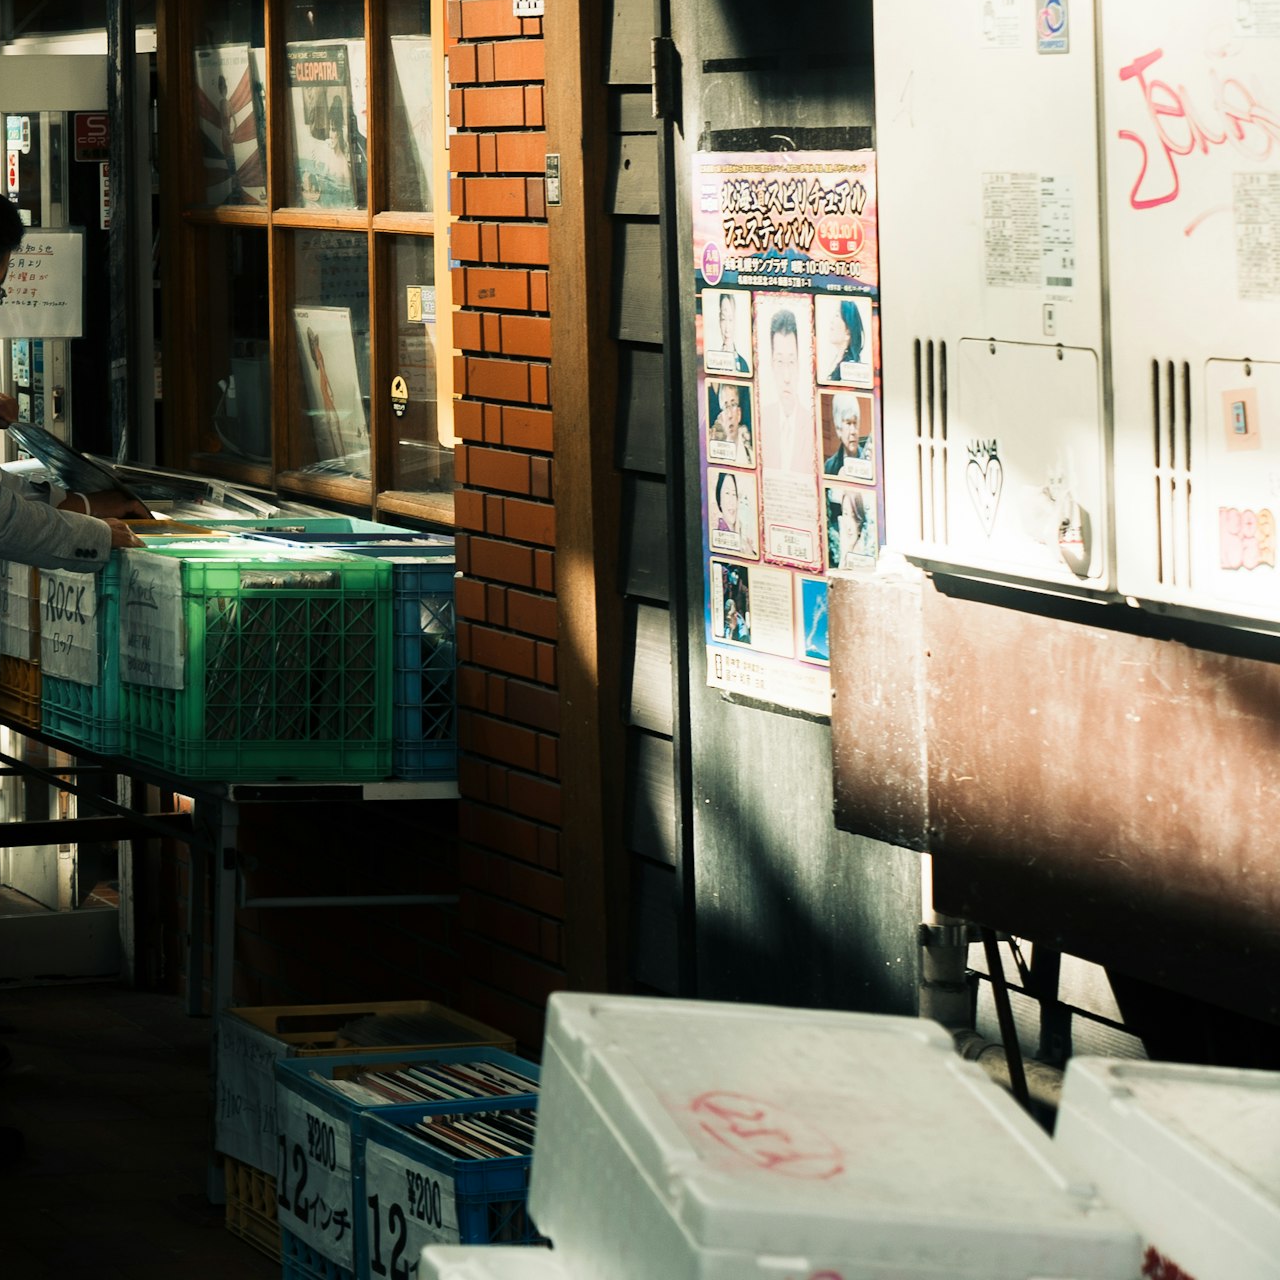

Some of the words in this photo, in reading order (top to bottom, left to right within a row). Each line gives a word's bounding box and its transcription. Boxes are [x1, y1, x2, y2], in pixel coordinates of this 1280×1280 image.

[296, 61, 338, 82] CLEOPATRA
[721, 178, 867, 216] 北海道スピリチュアル
[723, 216, 815, 253] フェスティバル
[46, 578, 85, 625] ROCK
[53, 633, 74, 655] ロック
[306, 1113, 336, 1171] ¥200
[406, 1169, 442, 1228] ¥200
